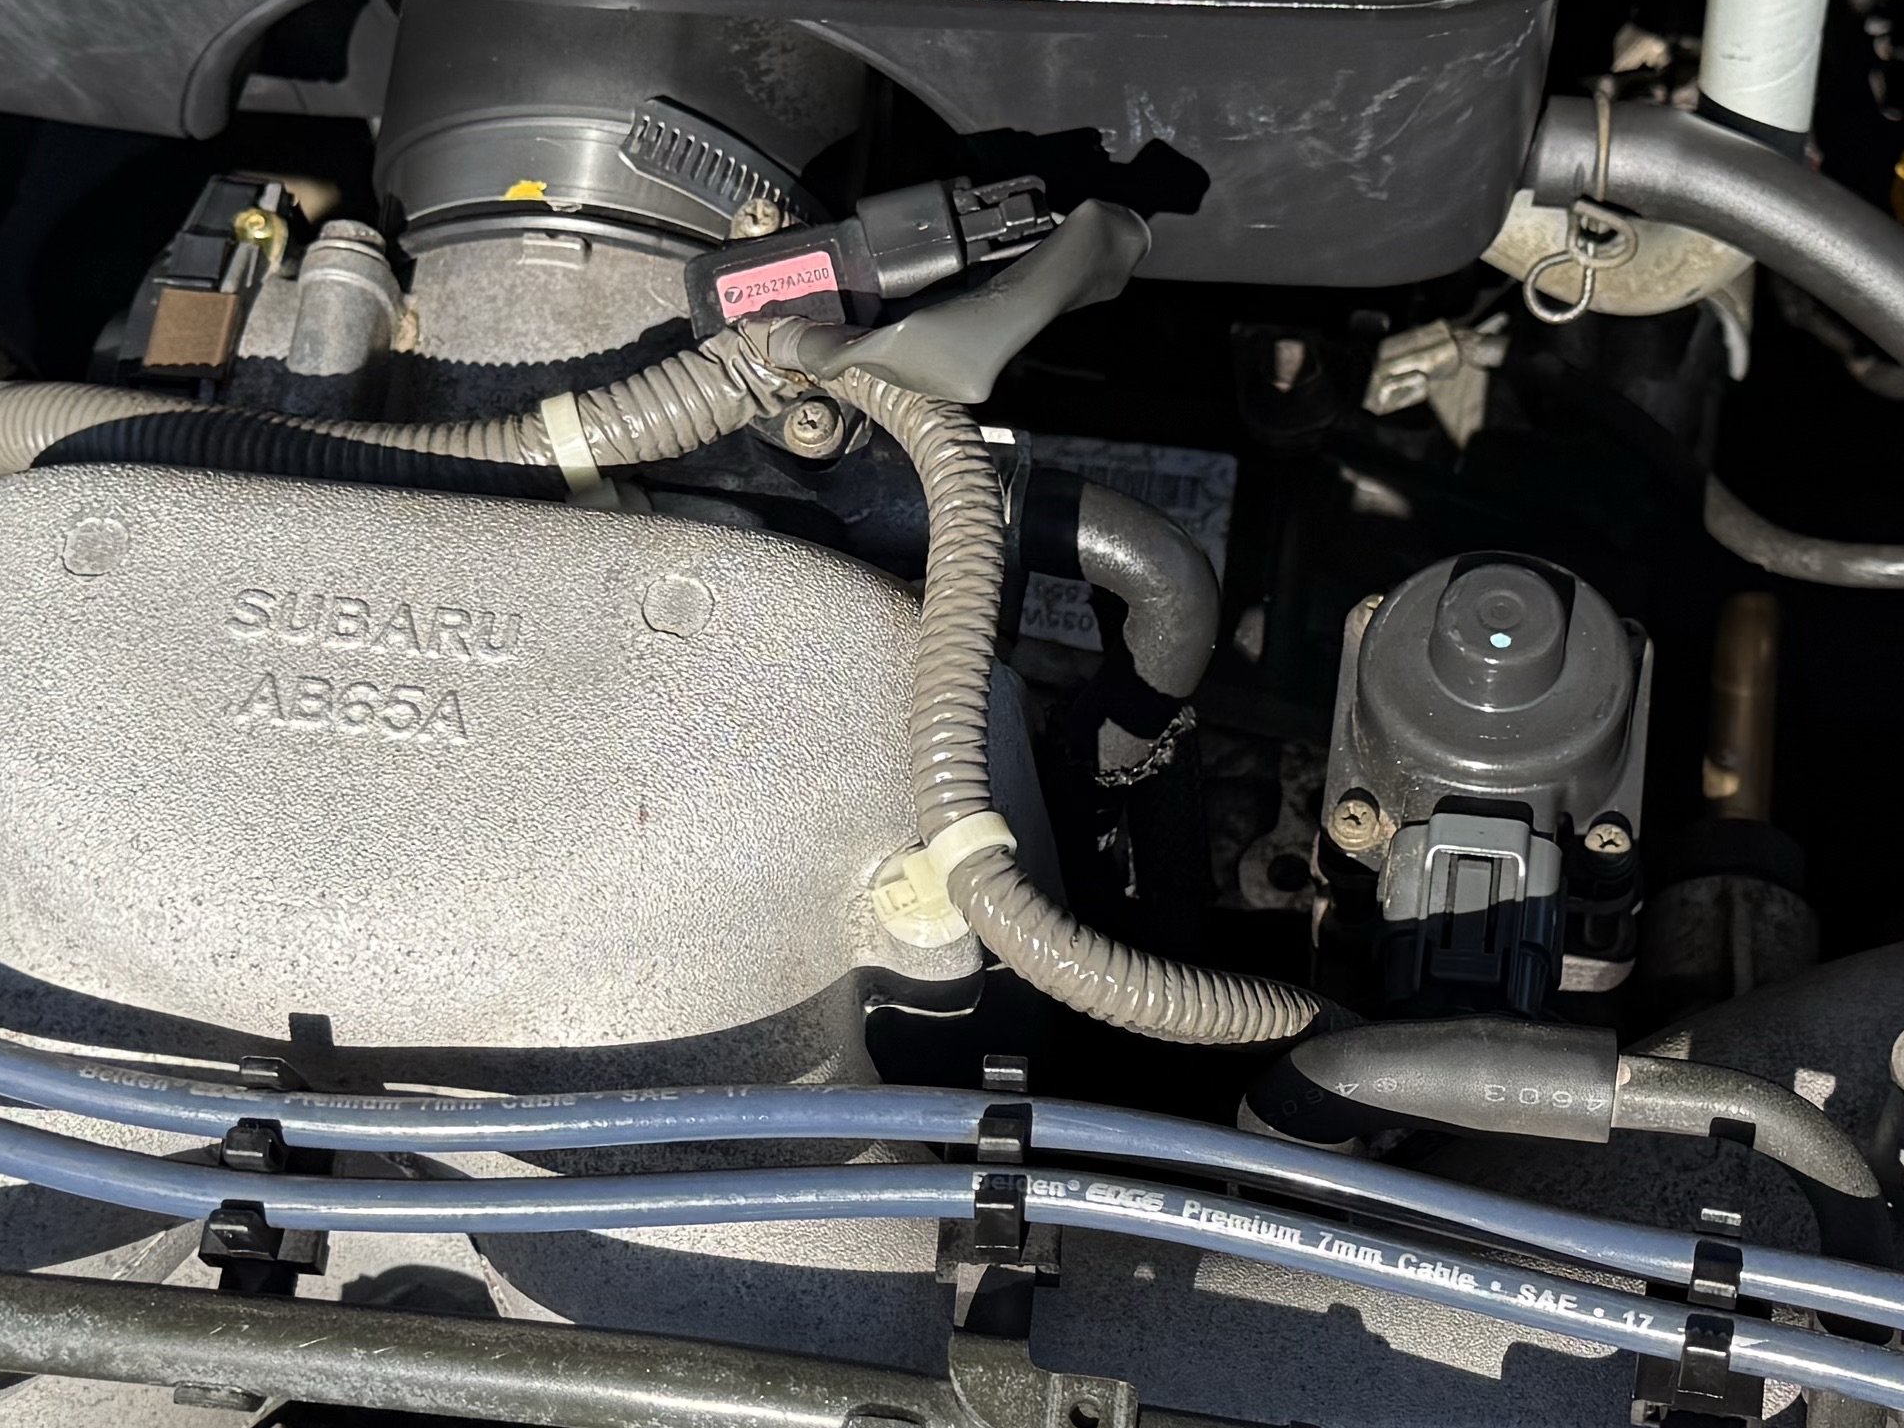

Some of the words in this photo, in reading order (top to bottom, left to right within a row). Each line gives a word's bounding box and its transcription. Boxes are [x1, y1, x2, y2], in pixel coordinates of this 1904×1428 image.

[746, 267, 830, 299] 22627AA200
[227, 587, 522, 663] SUBARU
[233, 673, 470, 742] AB65A
[1482, 1083, 1609, 1117] 4603
[1084, 1182, 1165, 1213] EDGE
[1182, 1198, 1305, 1248] Premium
[1316, 1229, 1384, 1266] 7mm
[1397, 1252, 1476, 1295] Cable
[1516, 1283, 1578, 1315] SAE
[1620, 1308, 1655, 1333] 17
